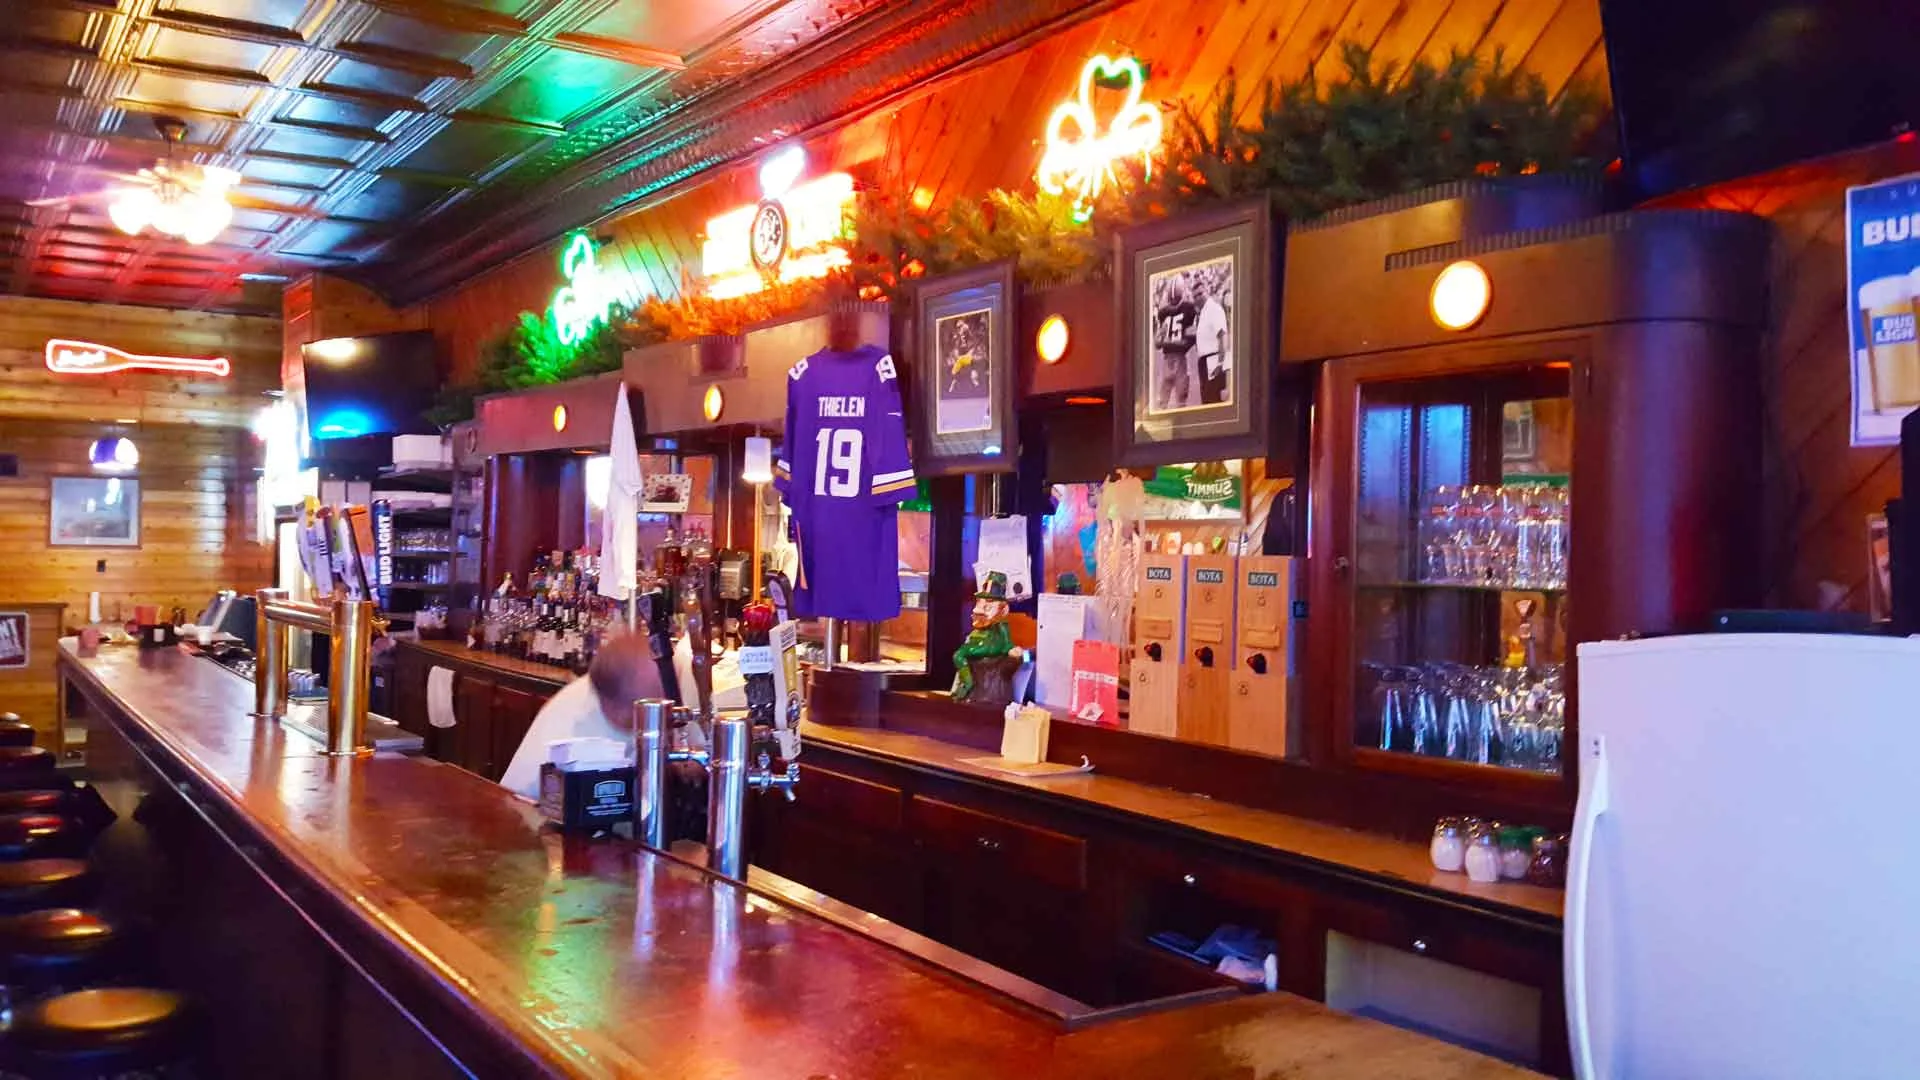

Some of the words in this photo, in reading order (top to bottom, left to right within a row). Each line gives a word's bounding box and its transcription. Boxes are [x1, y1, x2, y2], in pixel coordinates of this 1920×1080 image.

[1164, 312, 1184, 342] 15
[818, 396, 865, 417] THIELEN
[814, 428, 863, 497] 19
[378, 515, 392, 554] LIGHT
[379, 555, 392, 585] BUD
[1148, 568, 1170, 579] BOTA
[1198, 571, 1221, 581] BOTA
[1250, 574, 1275, 584] BOTA
